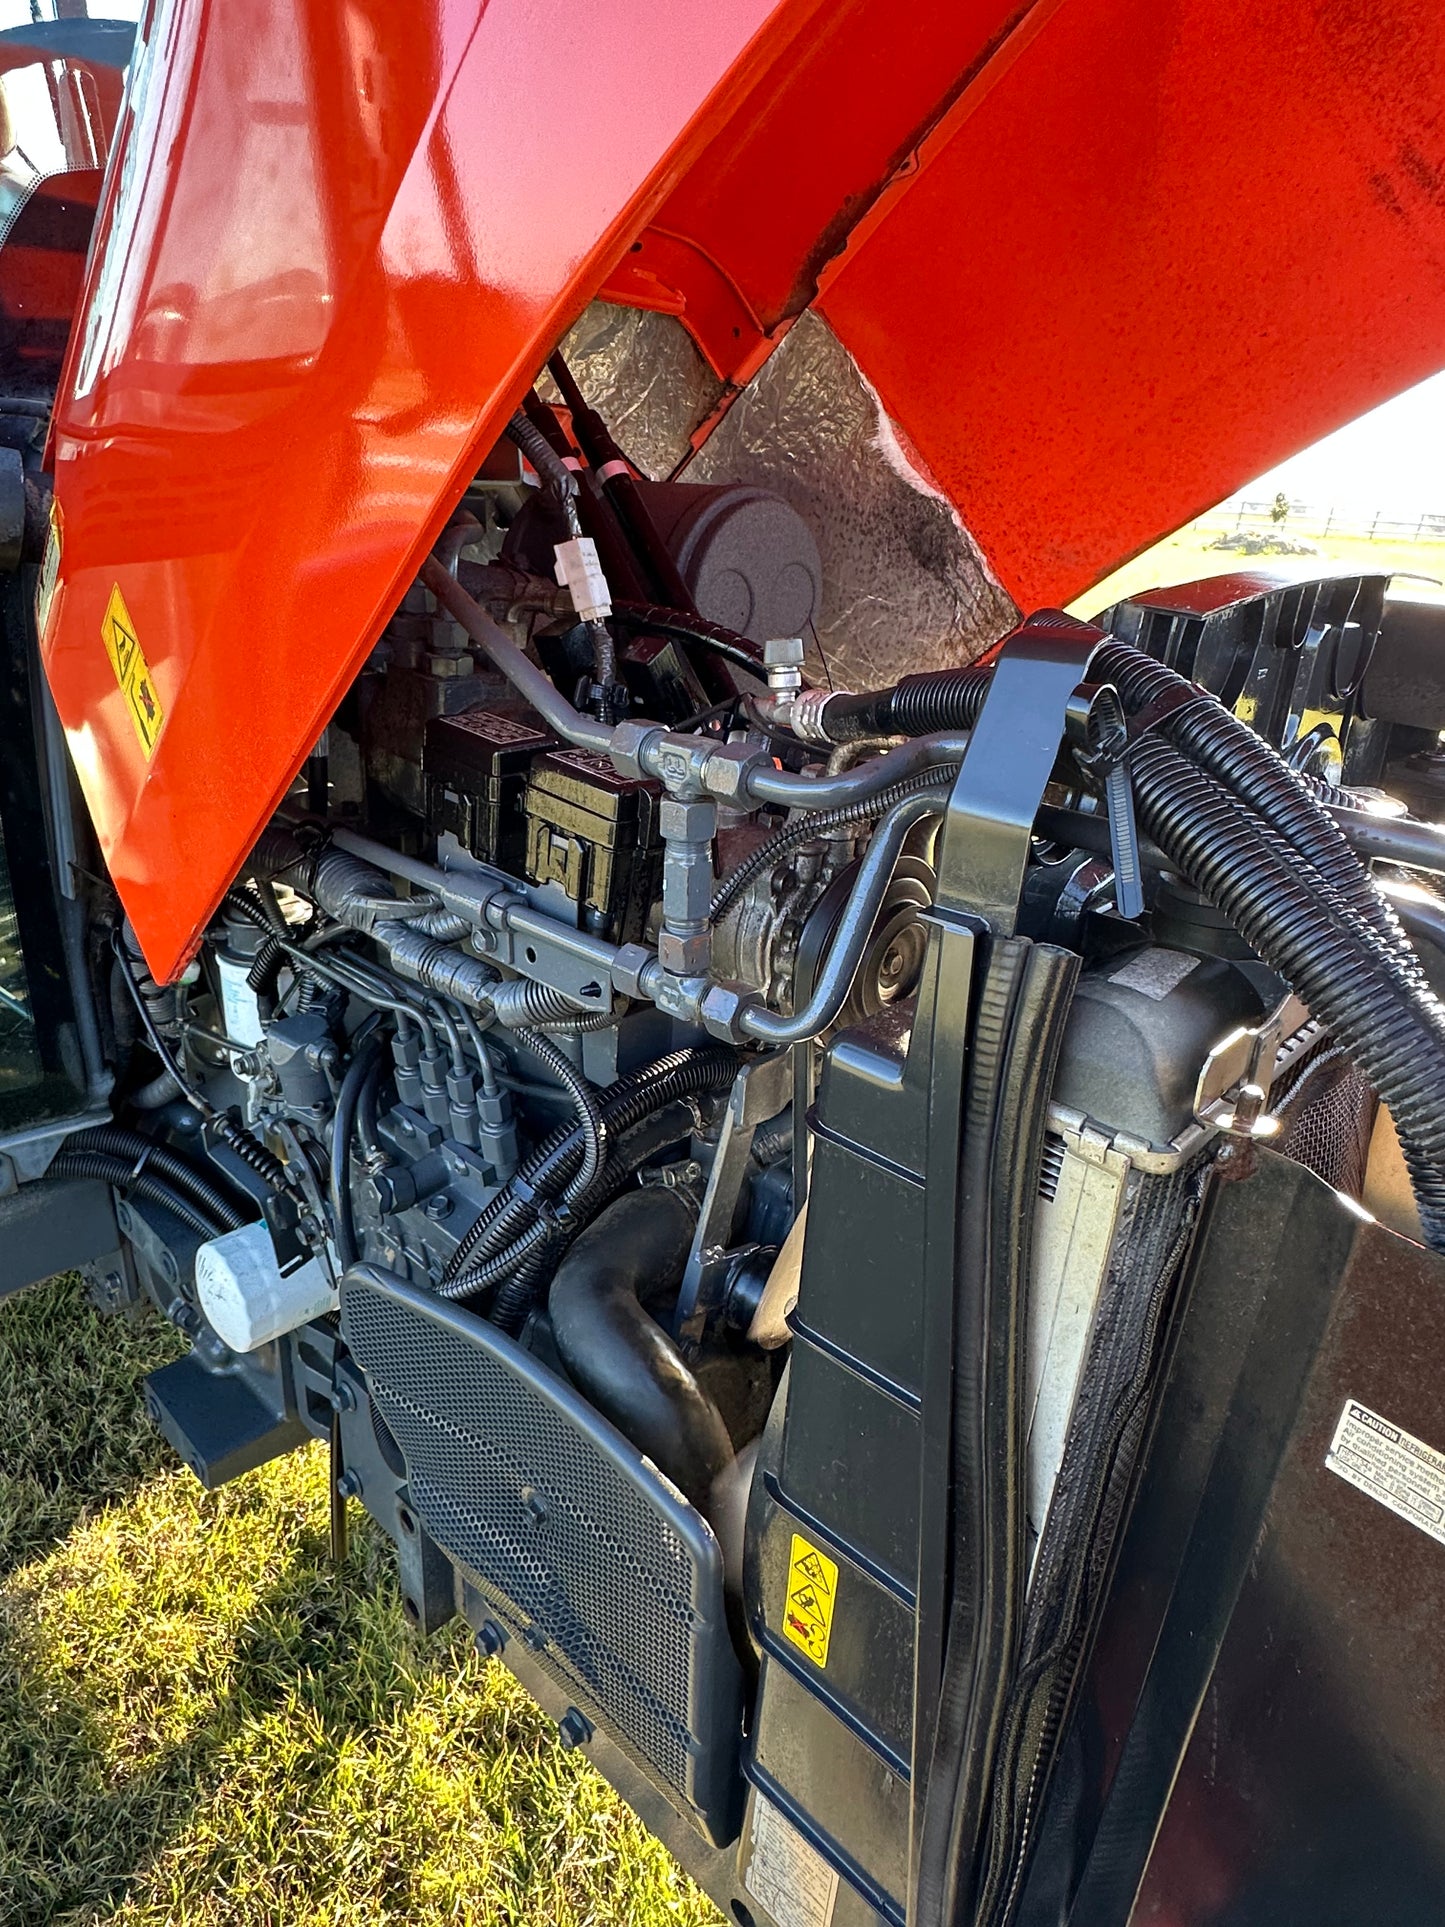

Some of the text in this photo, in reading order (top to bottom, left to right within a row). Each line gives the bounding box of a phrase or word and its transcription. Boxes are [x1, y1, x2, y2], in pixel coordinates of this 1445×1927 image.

[1340, 1434, 1351, 1445] by
[1361, 1413, 1398, 1441] CAUTION
[1343, 1427, 1355, 1439] Air
[1356, 1435, 1407, 1472] conditioning
[1409, 1469, 1440, 1493] system
[1346, 1420, 1445, 1487] Improper service metho
